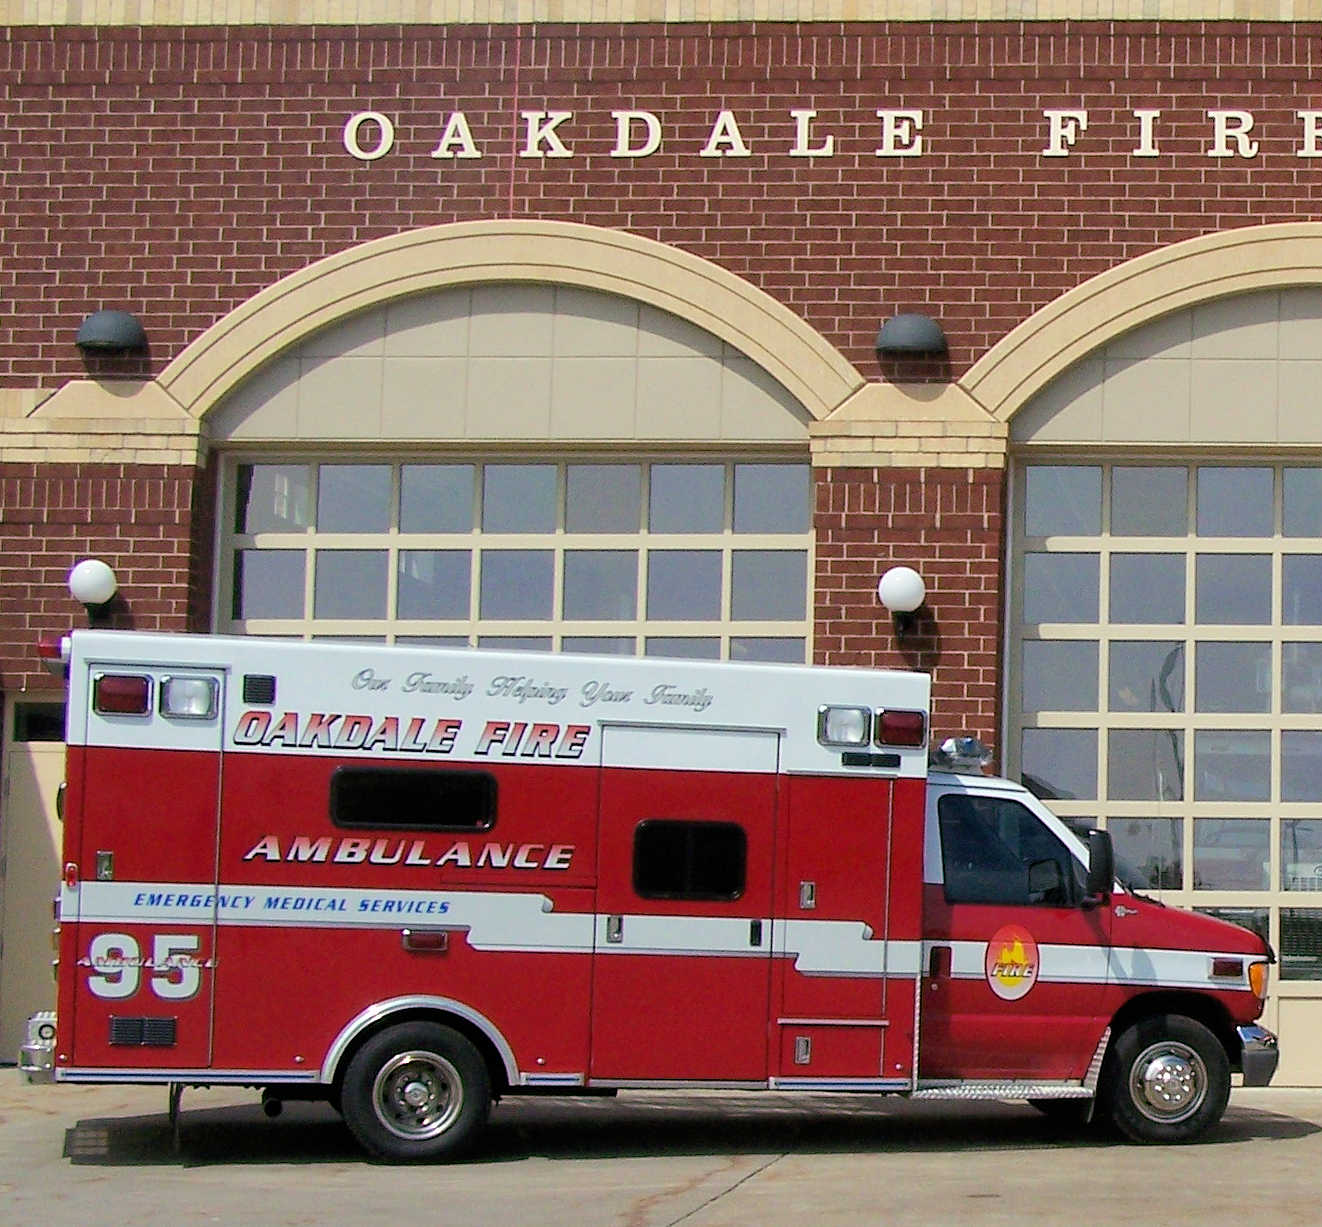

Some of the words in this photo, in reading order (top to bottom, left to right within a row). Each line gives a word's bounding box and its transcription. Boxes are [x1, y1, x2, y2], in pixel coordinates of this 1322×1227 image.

[342, 110, 924, 160] OAKDALE
[352, 668, 391, 691] Our
[401, 671, 475, 700] Family
[486, 675, 569, 704] Helping
[579, 679, 634, 708] Your
[642, 683, 714, 711] Family
[232, 709, 464, 758] OAKDALE
[475, 718, 594, 762] FIRE
[242, 834, 577, 872] AMBULANCE
[133, 891, 256, 910] EMERGENCY
[263, 895, 349, 913] MEDICAL
[358, 897, 452, 916] SERVICES
[87, 932, 203, 1001] 95
[990, 961, 1035, 978] FIRE
